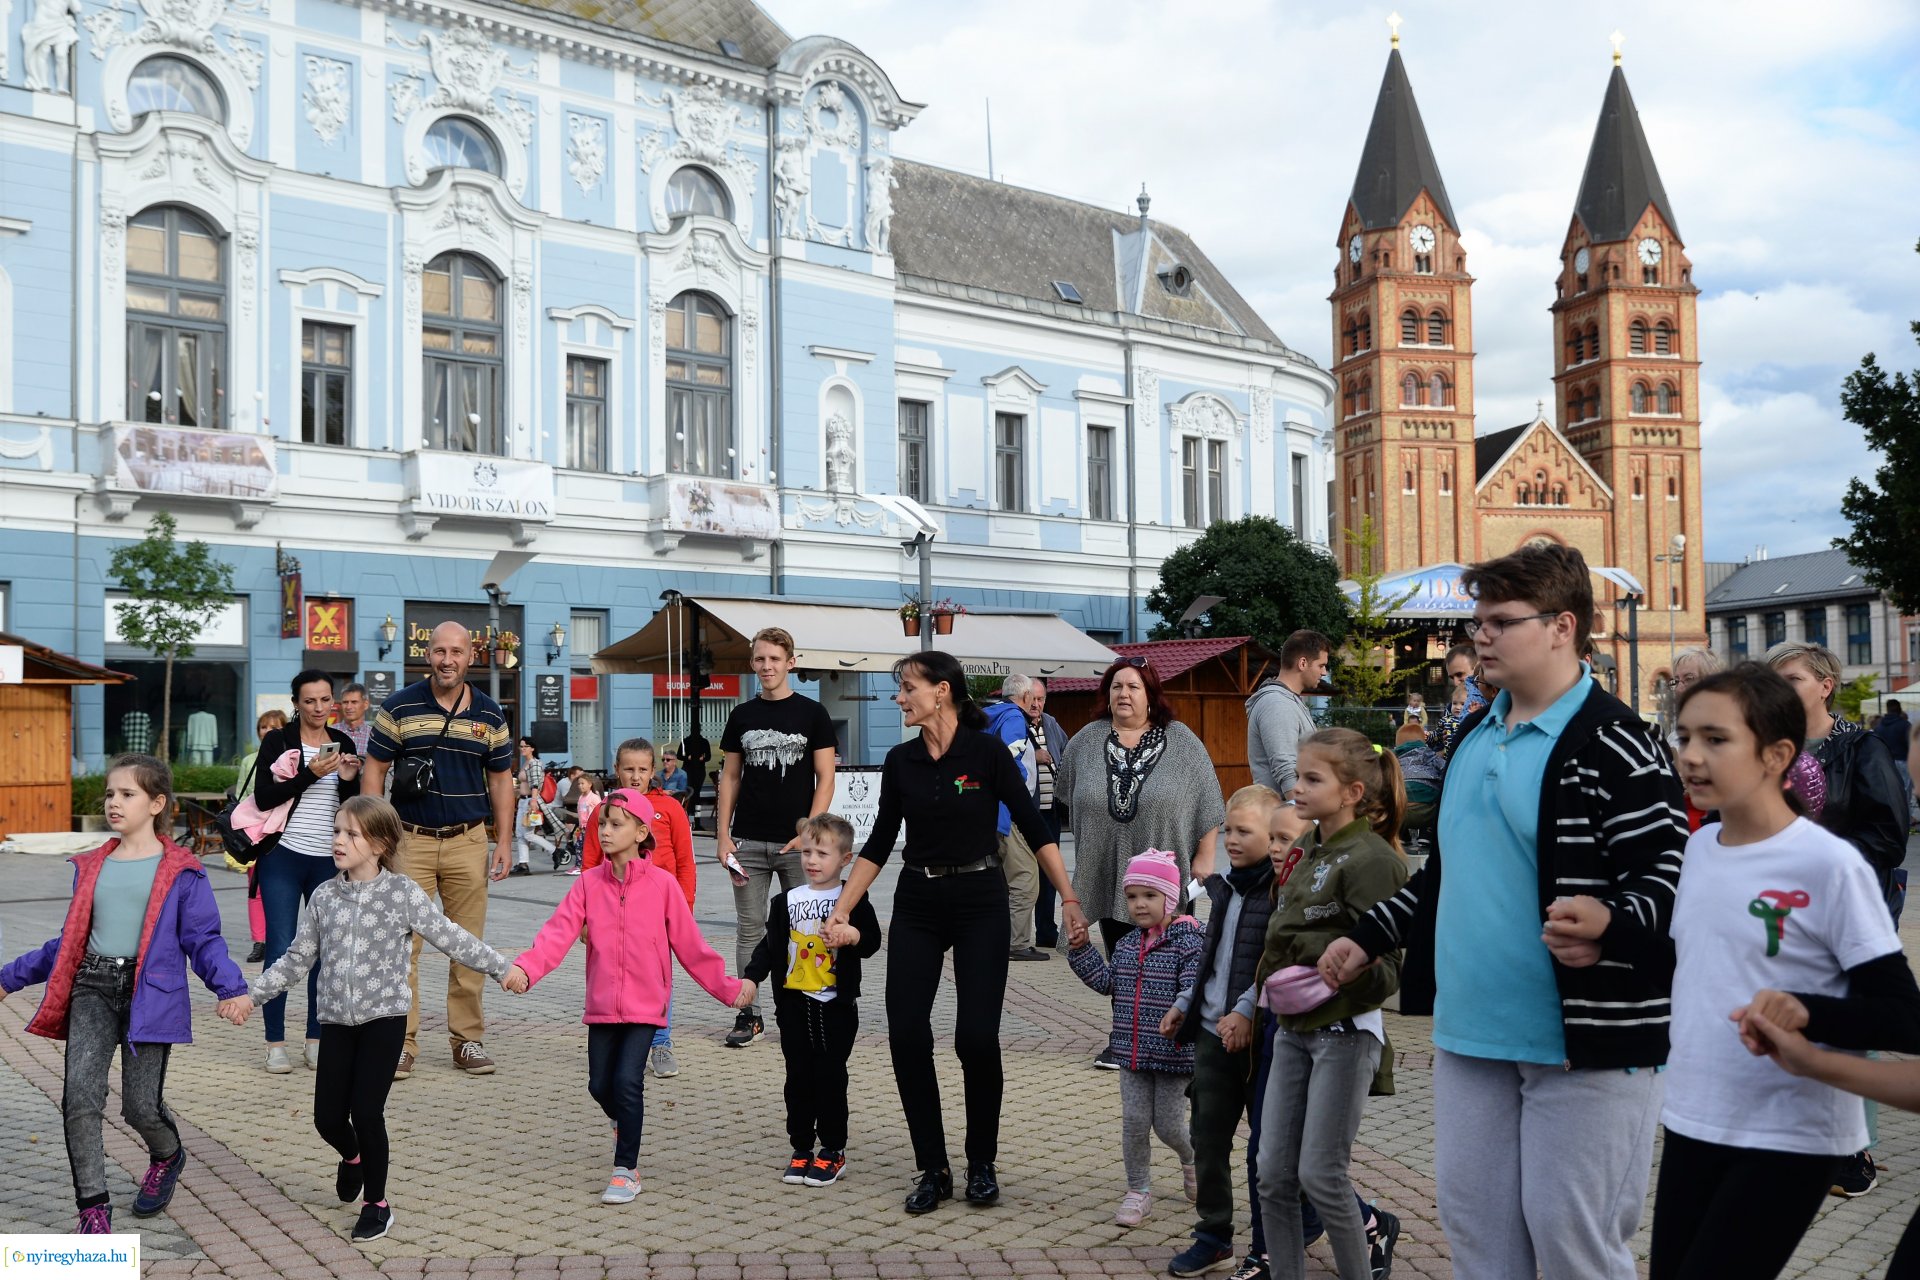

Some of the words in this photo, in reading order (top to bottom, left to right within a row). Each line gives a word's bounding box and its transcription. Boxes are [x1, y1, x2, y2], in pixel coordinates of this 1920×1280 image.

[427, 493, 482, 511] VIDOR
[486, 498, 549, 515] SZALON
[313, 606, 340, 633] X
[312, 634, 341, 645] CAFÉ
[960, 661, 990, 674] ORONA
[666, 682, 691, 690] BUDAP
[788, 899, 838, 931] PIKACH
